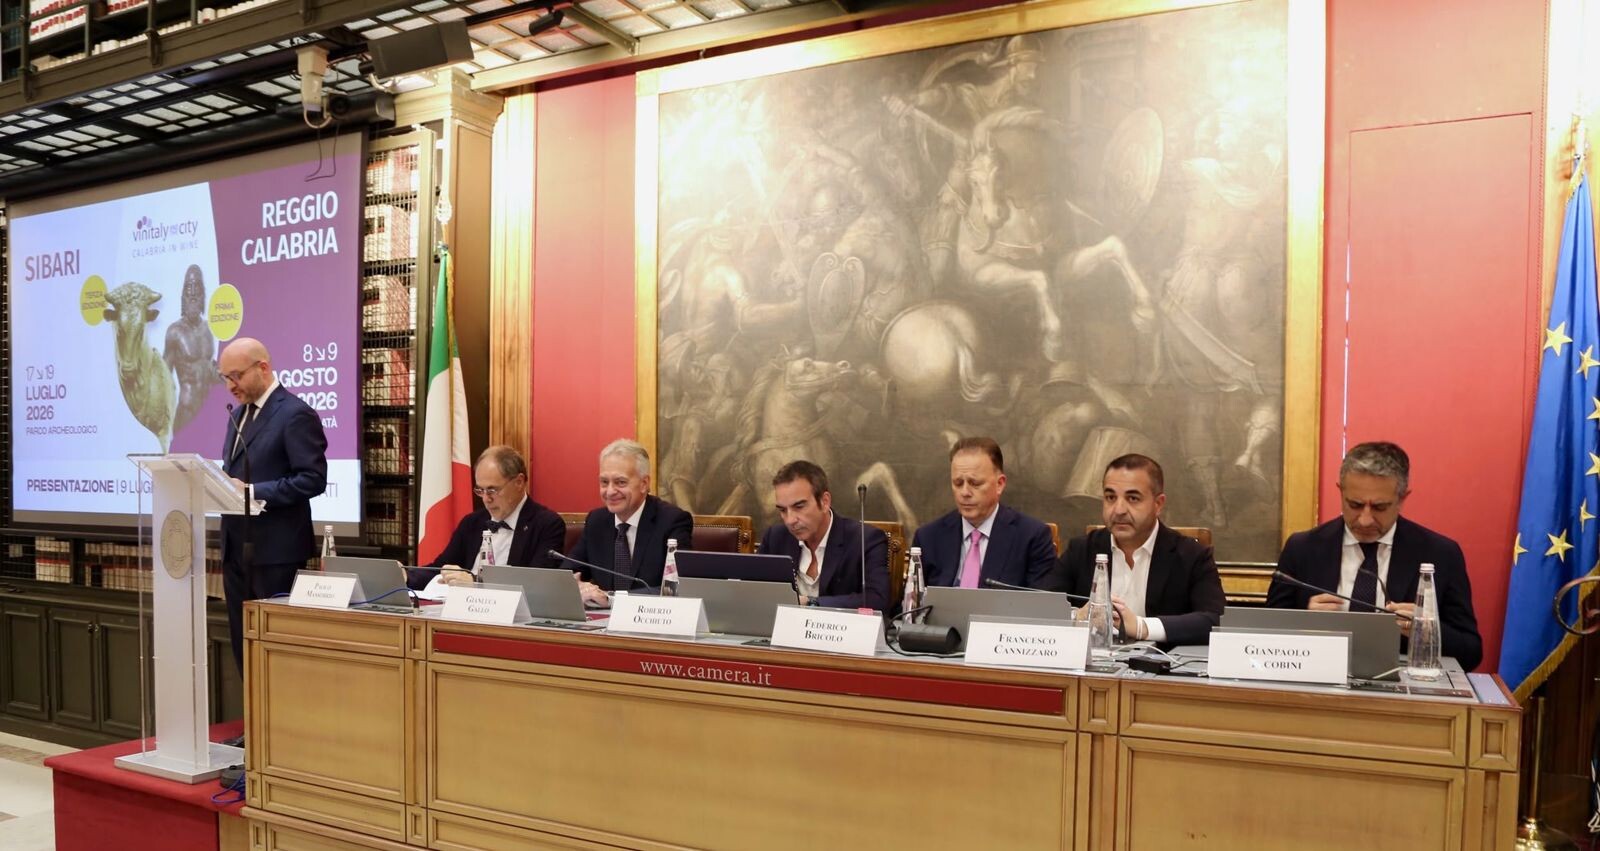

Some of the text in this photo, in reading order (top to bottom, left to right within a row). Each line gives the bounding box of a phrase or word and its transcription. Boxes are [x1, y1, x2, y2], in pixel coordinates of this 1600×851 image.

[262, 190, 339, 228] REGGIO
[132, 221, 169, 242] vinitaly
[179, 220, 198, 237] city
[241, 226, 339, 266] CALABRIA
[25, 249, 80, 281] SIBARI
[303, 341, 338, 363] 8 9
[26, 364, 54, 381] 17 19
[26, 384, 67, 401] LUGLIO
[26, 405, 54, 421] 2026
[26, 425, 98, 436] PARCO ARCHEOLOGICO
[27, 478, 114, 494] PRESENTAZIONE
[120, 479, 128, 494] 9
[468, 605, 490, 613] GALLO
[637, 604, 672, 614] ROBERTO
[804, 619, 848, 631] FEDERICO
[804, 630, 843, 642] BRICOLO
[999, 633, 1056, 644] FRANCESCO
[994, 645, 1058, 657] CANNIZZARO
[1244, 644, 1310, 657] GIANPAOLO
[639, 661, 772, 686] www.camera.it
